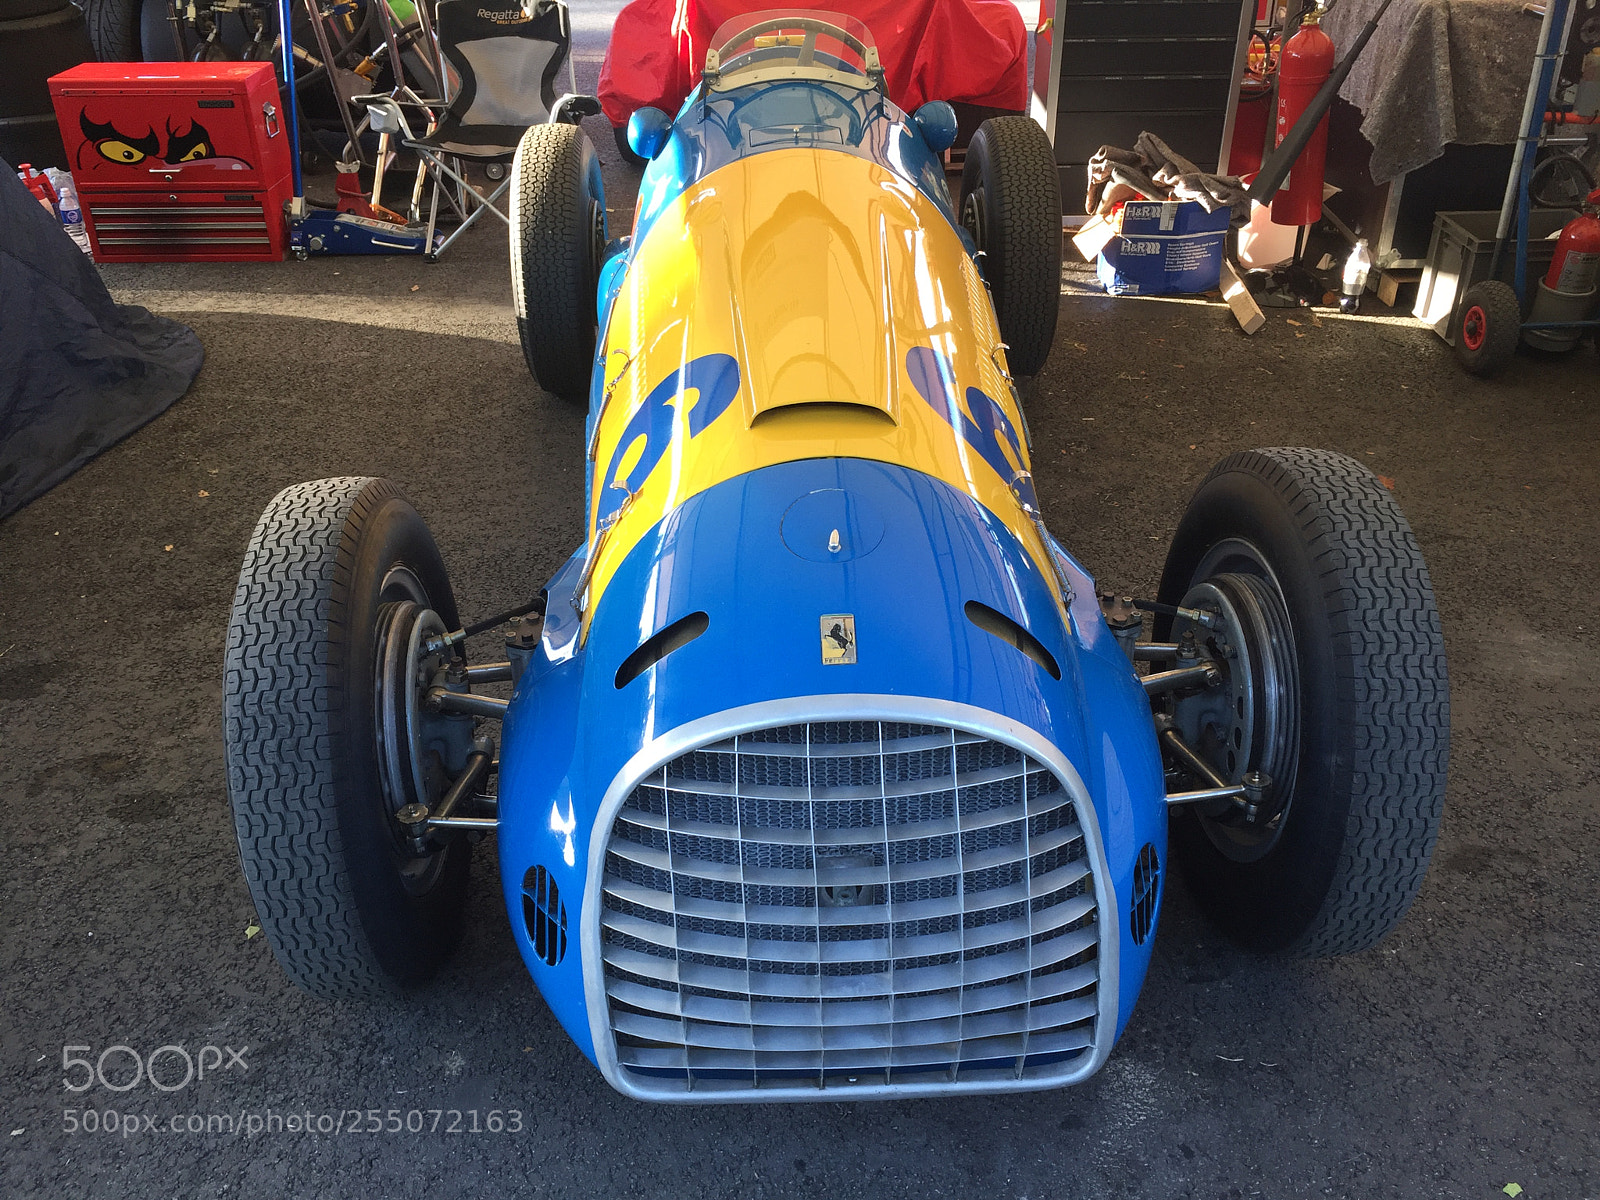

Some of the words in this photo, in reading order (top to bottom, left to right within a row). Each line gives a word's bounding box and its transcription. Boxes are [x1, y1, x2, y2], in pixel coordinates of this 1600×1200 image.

[477, 8, 520, 22] Regatta
[1126, 206, 1151, 217] H&R
[1121, 241, 1146, 253] H&R
